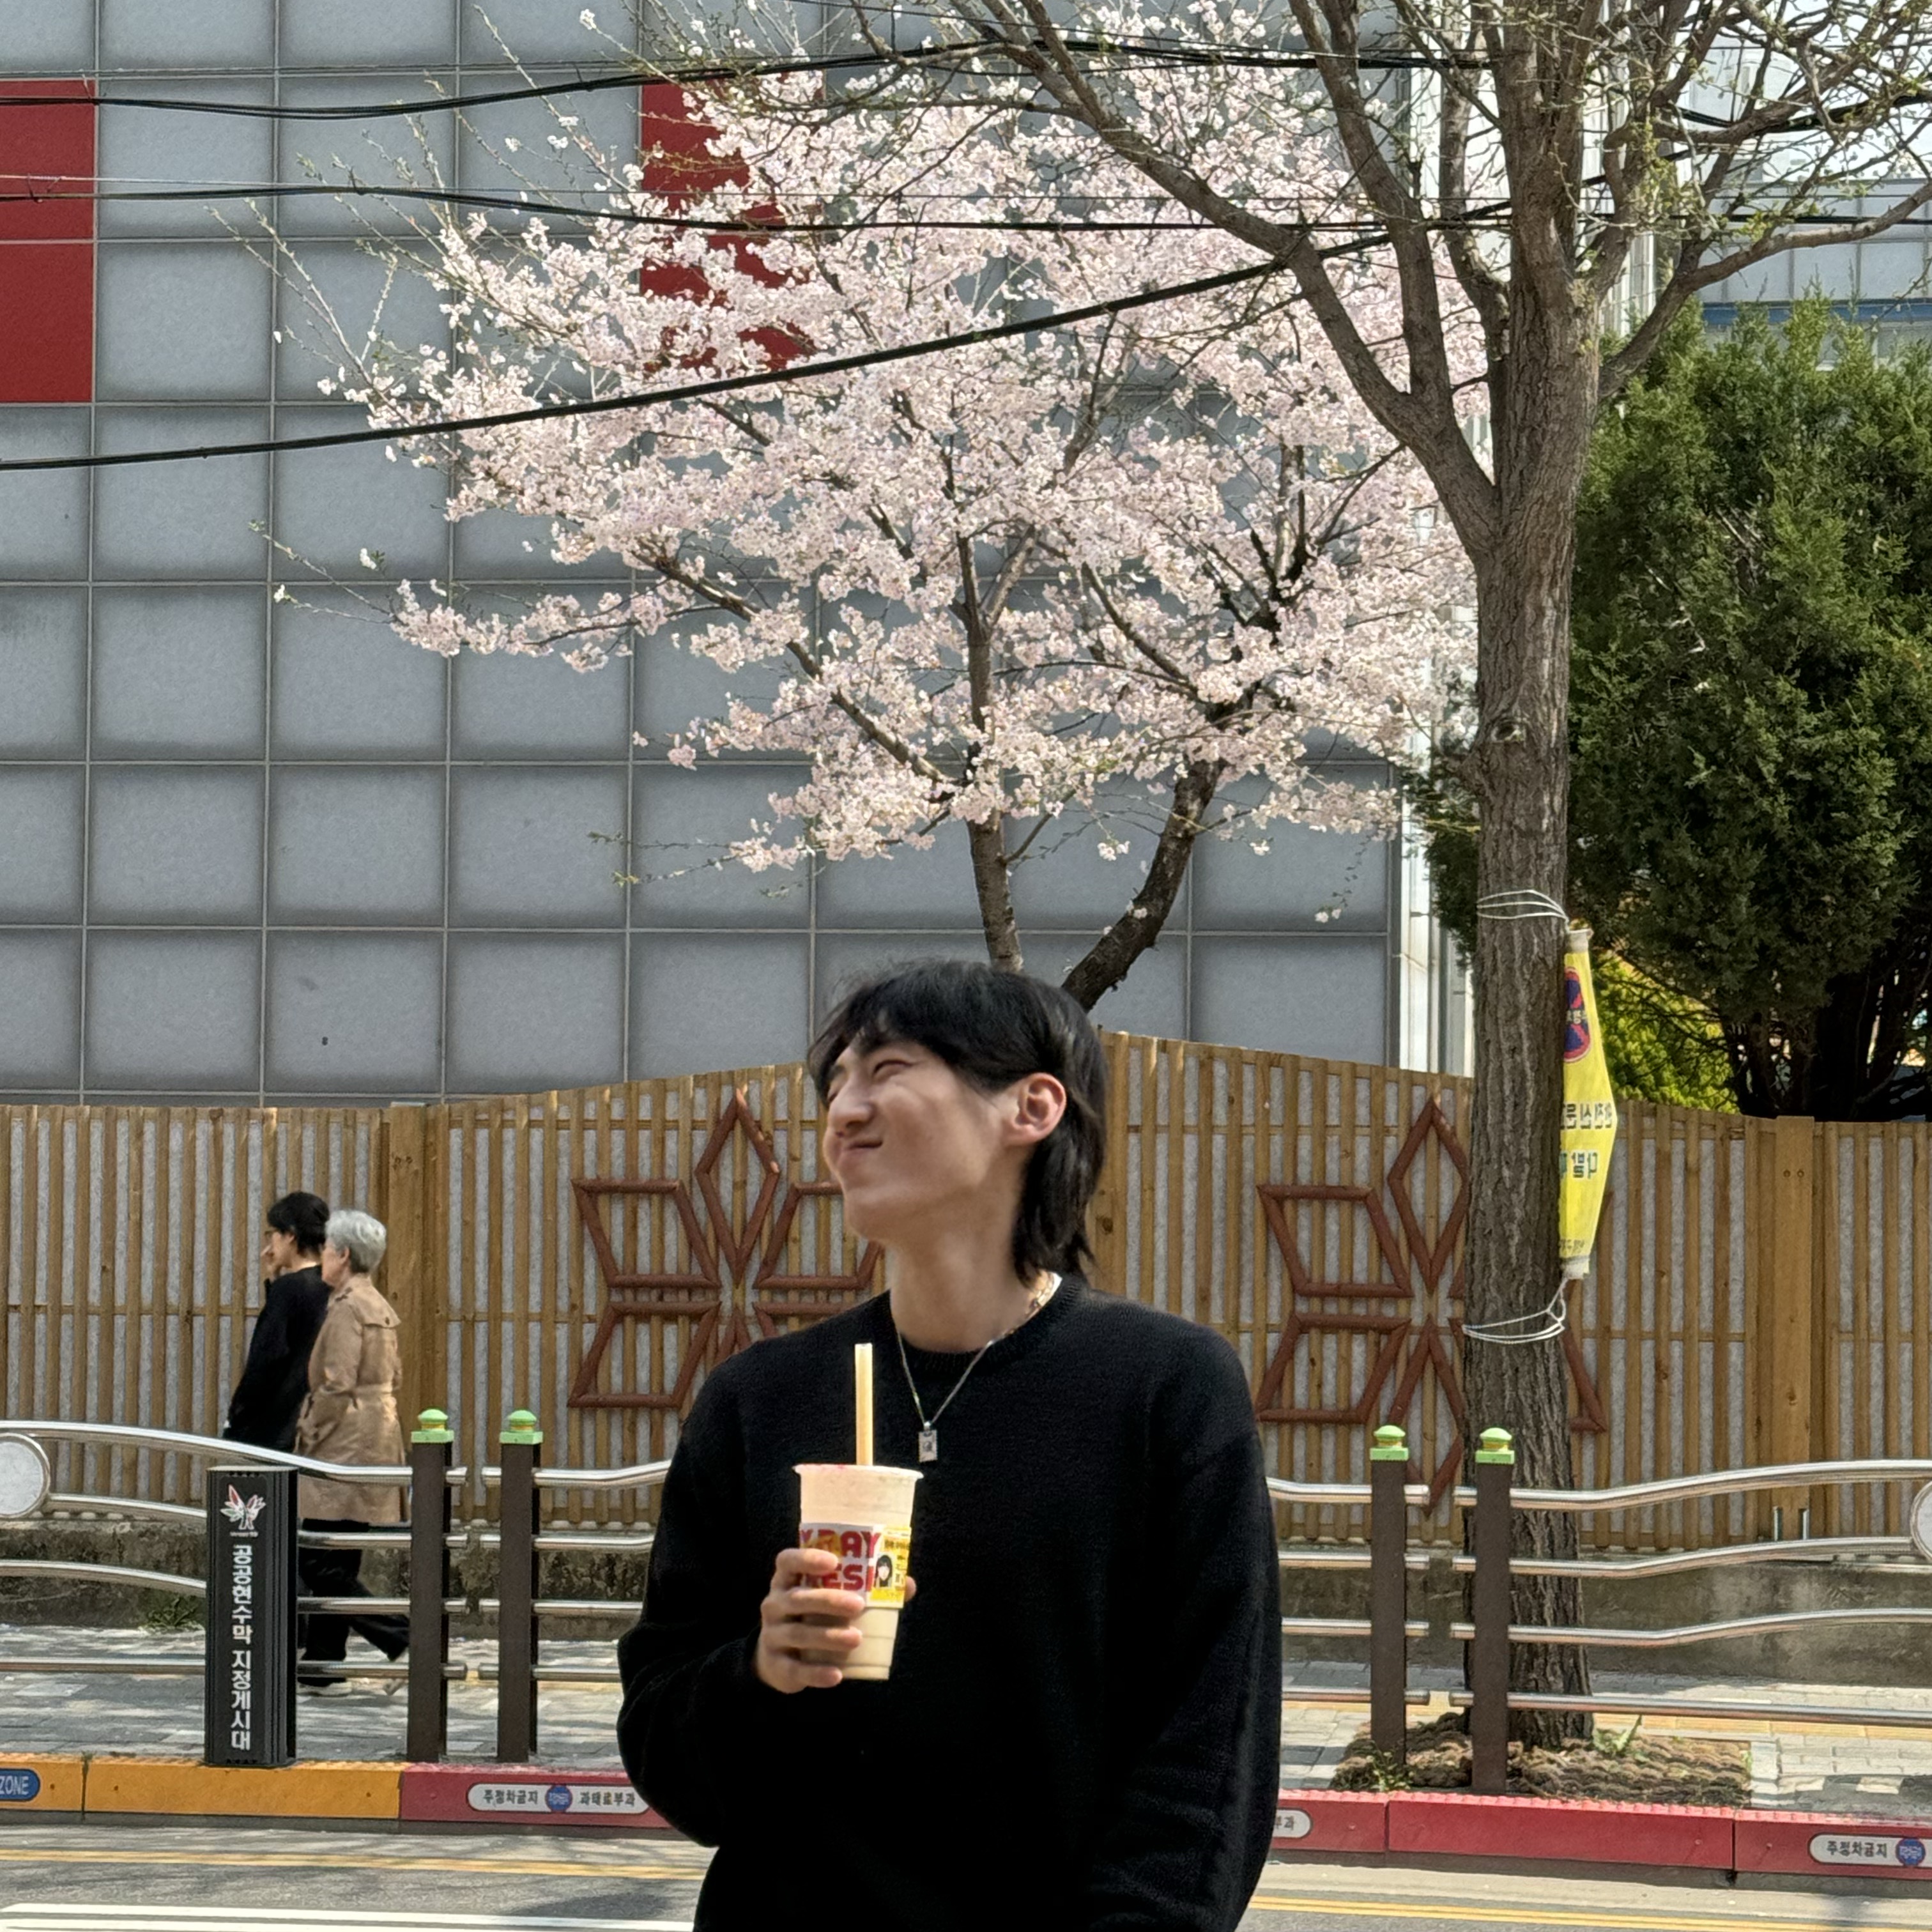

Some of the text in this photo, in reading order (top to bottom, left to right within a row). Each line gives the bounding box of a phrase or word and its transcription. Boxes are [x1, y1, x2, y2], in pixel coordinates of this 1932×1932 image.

[231, 1544, 253, 1645] 공공현수막
[231, 1650, 251, 1751] 지정게시대
[0, 1775, 29, 1795] ZONE
[483, 1790, 538, 1805] 주정차금지
[578, 1790, 636, 1807] 과태료부과
[1827, 1841, 1887, 1858] 주정차금지
